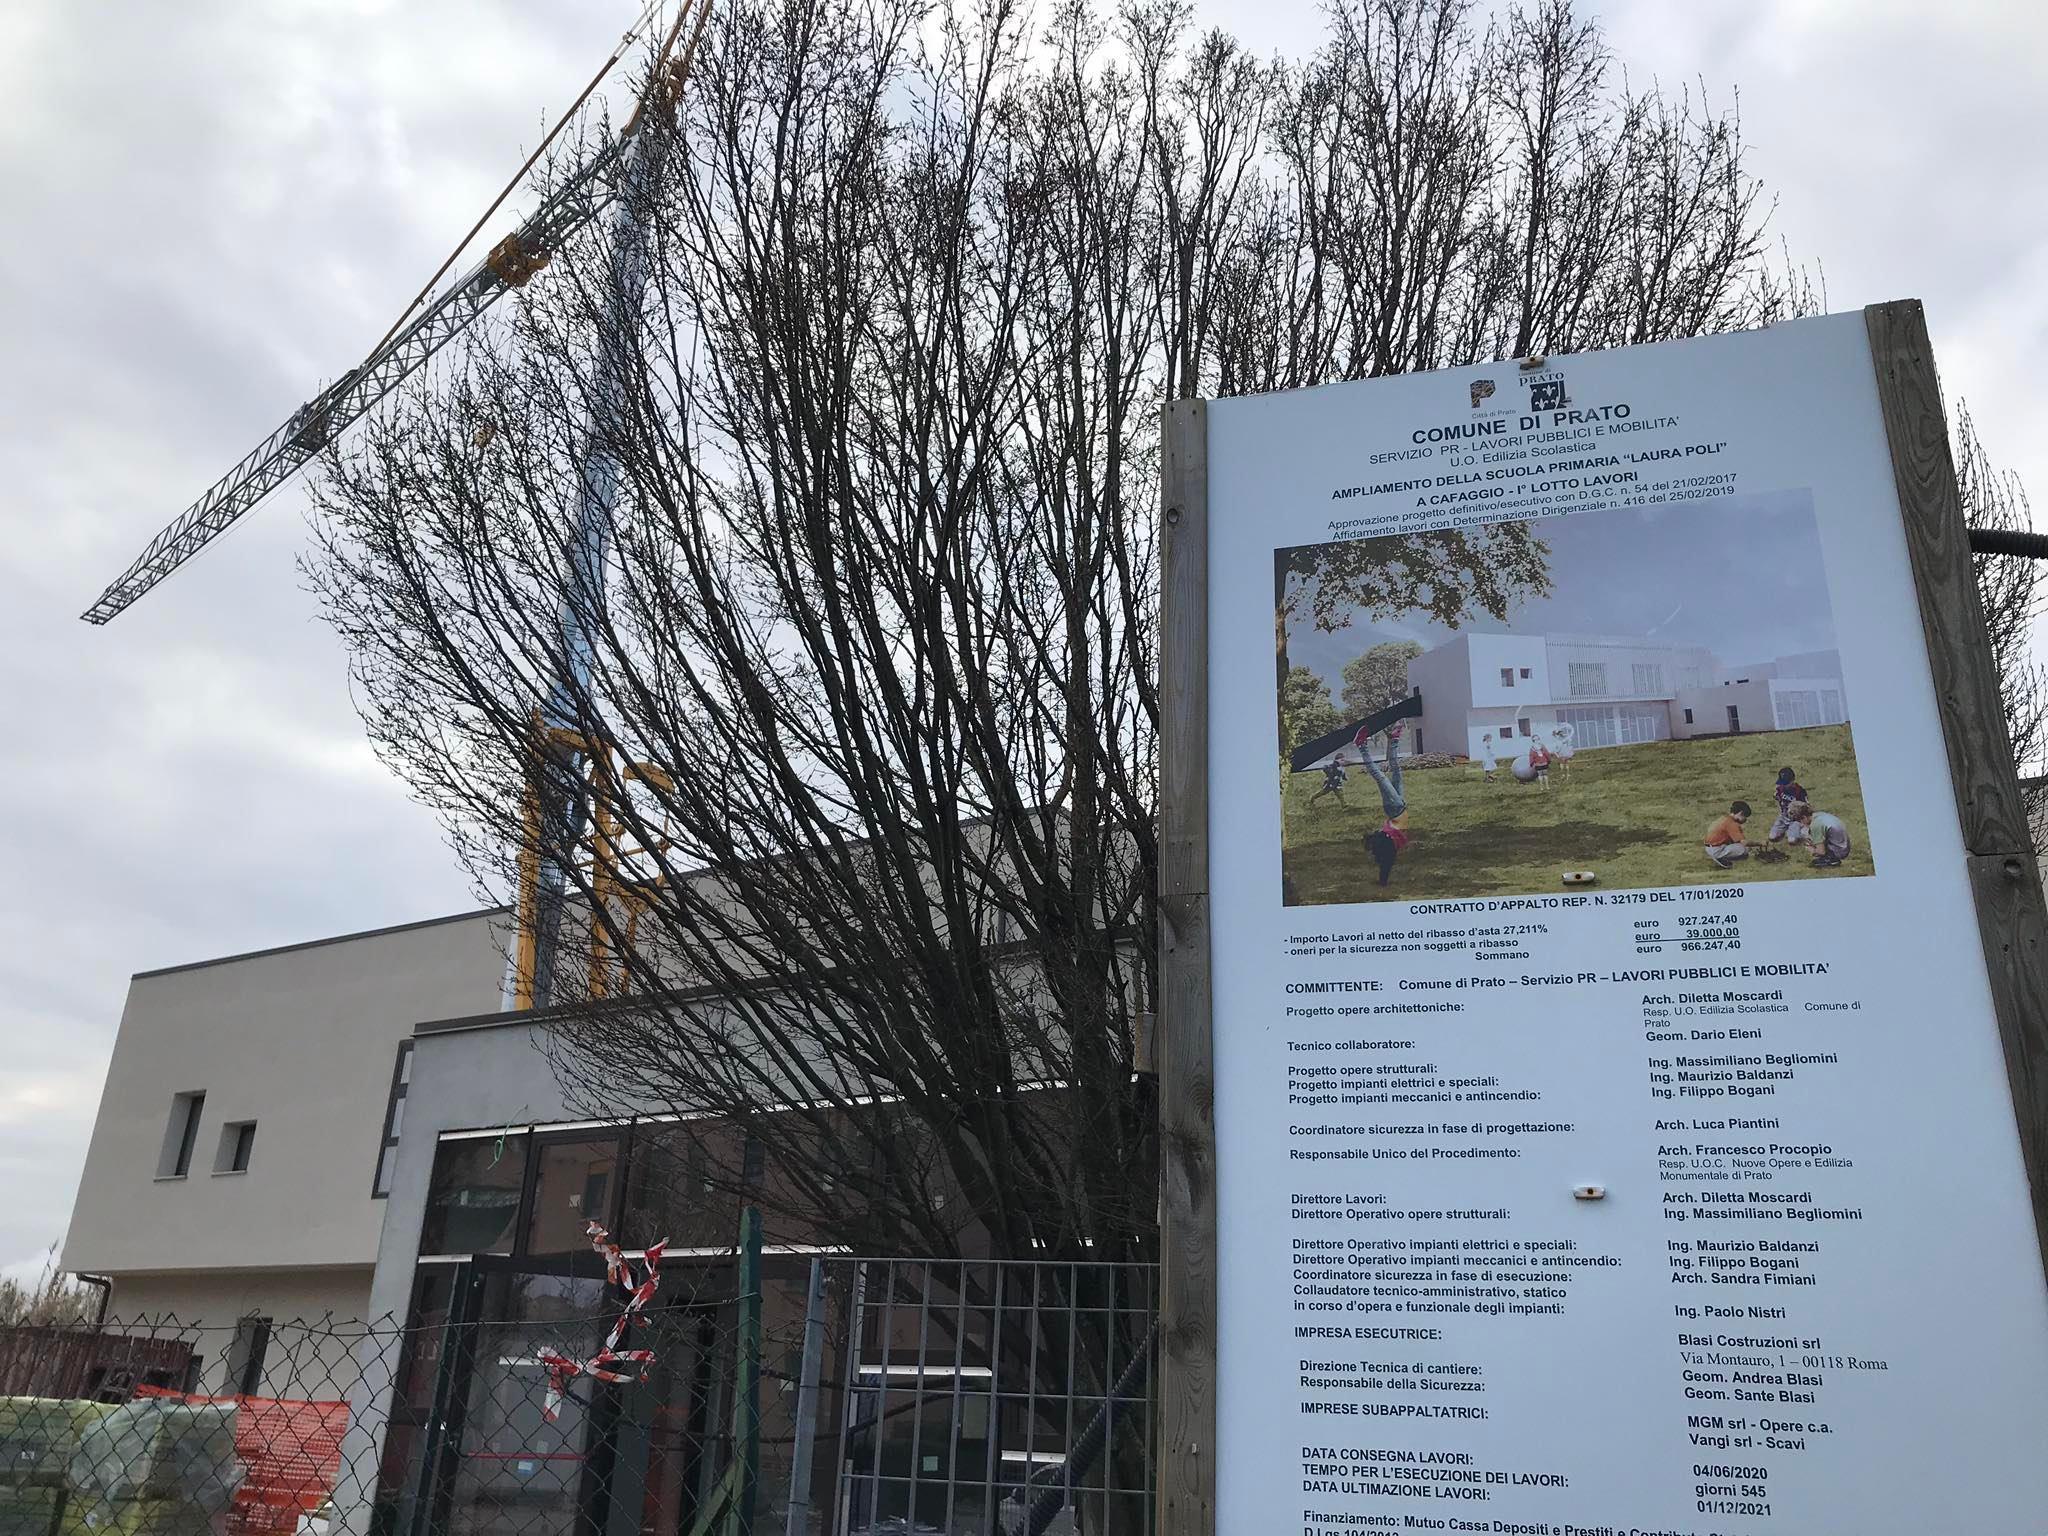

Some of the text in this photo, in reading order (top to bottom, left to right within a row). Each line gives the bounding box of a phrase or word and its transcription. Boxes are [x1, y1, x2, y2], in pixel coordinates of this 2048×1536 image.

[1518, 372, 1565, 387] PRATO
[1412, 403, 1630, 444] COMUNE DI PRATO
[1369, 446, 1433, 464] SERVIZIO
[1440, 444, 1460, 456] PR
[1471, 435, 1522, 452] LAVORI
[1526, 426, 1591, 446] PUBBLICI
[1595, 424, 1605, 436] E
[1450, 440, 1599, 467] U.O. Edilizia Scolastica
[1331, 478, 1432, 500] AMPLIAMENTO
[1436, 472, 1482, 487] DELLA
[1485, 464, 1545, 480] SCUOLA
[1548, 455, 1620, 473] PRIMARIA
[1415, 496, 1427, 508] A
[1430, 487, 1504, 505] CAFAGGIO
[1530, 478, 1579, 493] LOTTO
[1583, 471, 1638, 487] LAVORI
[1327, 472, 1737, 531] Approvazione progetto definitivo/esecutivo con D.G.C. n. 54 del 21/02/2017
[1409, 901, 1485, 915] CONTRATTO
[1561, 896, 1591, 907] REP.
[1594, 895, 1607, 906] N.
[1610, 893, 1646, 904] 32179
[1649, 891, 1676, 902] DEL
[1679, 887, 1744, 904] 17/01/2020
[1633, 914, 1738, 929] euro 927.247,40
[1634, 927, 1740, 942] euro 39.000,00
[1636, 939, 1741, 954] euro 966.247,40
[1474, 950, 1530, 961] Sommano
[1285, 980, 1383, 994] COMMITTENTE:
[1398, 979, 1452, 991] Comune
[1455, 977, 1468, 988] di
[1470, 975, 1506, 987] Prato
[1520, 973, 1573, 986] Servizio
[1577, 972, 1597, 983] PR
[1612, 969, 1665, 982] LAVORI
[1668, 966, 1736, 980] PUBBLICI
[1740, 965, 1751, 977] E
[1641, 989, 1783, 1005] Arch. Diletta Moscardi
[1286, 1001, 1464, 1018] Progetto opere architettoniche:
[1642, 1001, 1861, 1018] Resp. U.O. Edilizia Scolastica Comune di
[1644, 1018, 1673, 1028] Prato
[1645, 1028, 1762, 1042] Geom. Dario Eleni
[1286, 1039, 1415, 1051] Tecnico collaboratore:
[1648, 1052, 1838, 1070] Ing. Massimiliano Begliomini
[1288, 1063, 1438, 1078] Progetto opere strutturali:
[1651, 1084, 1775, 1100] Ing. Filippo Bogani
[1289, 1121, 1574, 1136] Coordinatore sicurezza in fase di progettazione:
[1654, 1117, 1779, 1130] Arch. Luca Piantini
[1289, 1147, 1521, 1162] Responsabile Unico del Procedimento:
[1657, 1143, 1832, 1157] Arch. Francesco Procopio
[1658, 1157, 1853, 1171] Resp. U.O.C. Nuove Opere e Edilizia
[1291, 1193, 1386, 1205] Direttore Lavori:
[1671, 1271, 1816, 1285] Arch. Sandra Fimiani
[1674, 1304, 1786, 1319] Ing. Paolo Nistri
[1294, 1326, 1442, 1340] IMPRESA ESECUTRICE:
[1678, 1333, 1821, 1349] Blasi Costruzioni srl
[1299, 1359, 1482, 1376] Direzione Tecnica di cantiere:
[1679, 1351, 1704, 1366] Via
[1706, 1352, 1776, 1369] Montauro,
[1778, 1355, 1786, 1368] 1
[1802, 1356, 1844, 1370] 00118
[1846, 1356, 1888, 1370] Roma
[1682, 1369, 1823, 1386] Geom. Andrea Blasi
[1302, 1446, 1473, 1465] DATA CONSEGNA LAVORI:
[1692, 1464, 1768, 1483] 04/06/2020
[1302, 1480, 1490, 1500] DATA ULTIMAZIONE LAVORI:
[1695, 1482, 1766, 1500] giorni 545
[1696, 1499, 1771, 1516] 01/12/2021
